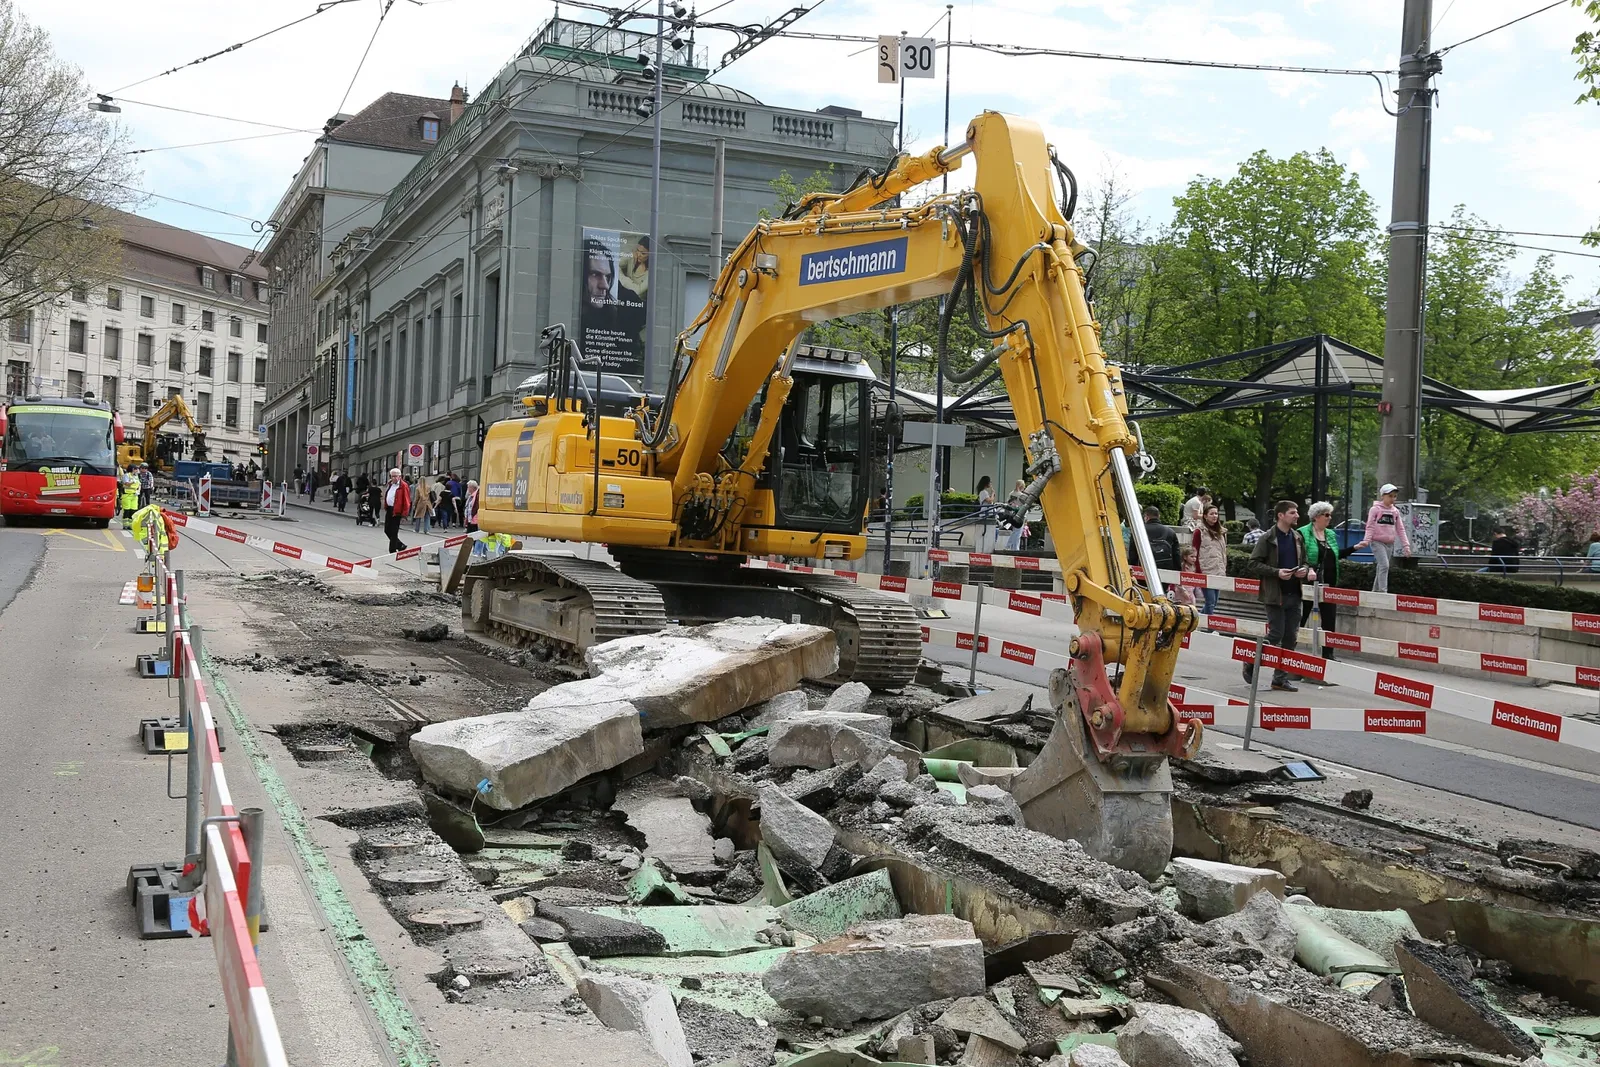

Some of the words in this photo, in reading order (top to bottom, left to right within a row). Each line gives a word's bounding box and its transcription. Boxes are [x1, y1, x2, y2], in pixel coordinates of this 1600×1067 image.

[880, 45, 888, 61] S
[904, 45, 931, 70] 30
[807, 248, 896, 280] bertschmann
[590, 296, 625, 306] Kunsthalle
[626, 300, 644, 308] Basel
[616, 448, 640, 466] 50
[515, 480, 527, 494] 210
[218, 528, 244, 540] bertschmann
[274, 545, 300, 556] bertschmann
[328, 560, 352, 570] bertschmann
[881, 580, 905, 588] bertschmann
[1181, 576, 1206, 584] bertschmann
[934, 586, 960, 595] bertschmann
[1324, 591, 1358, 602] bertschmann
[1010, 598, 1040, 611] bertschmann
[1398, 600, 1434, 610] bertschmann
[1480, 608, 1522, 620] bertschmann
[1208, 619, 1236, 628] bertschmann
[1326, 636, 1360, 648] bertschmann
[1003, 647, 1034, 660] bertschmann
[1400, 646, 1437, 658] bertschmann
[1482, 658, 1525, 672] bertschmann
[1378, 680, 1430, 701] bertschmann
[1262, 713, 1308, 722] bertschmann
[1367, 716, 1422, 728] bertschmann
[1495, 708, 1558, 734] bertschmann
